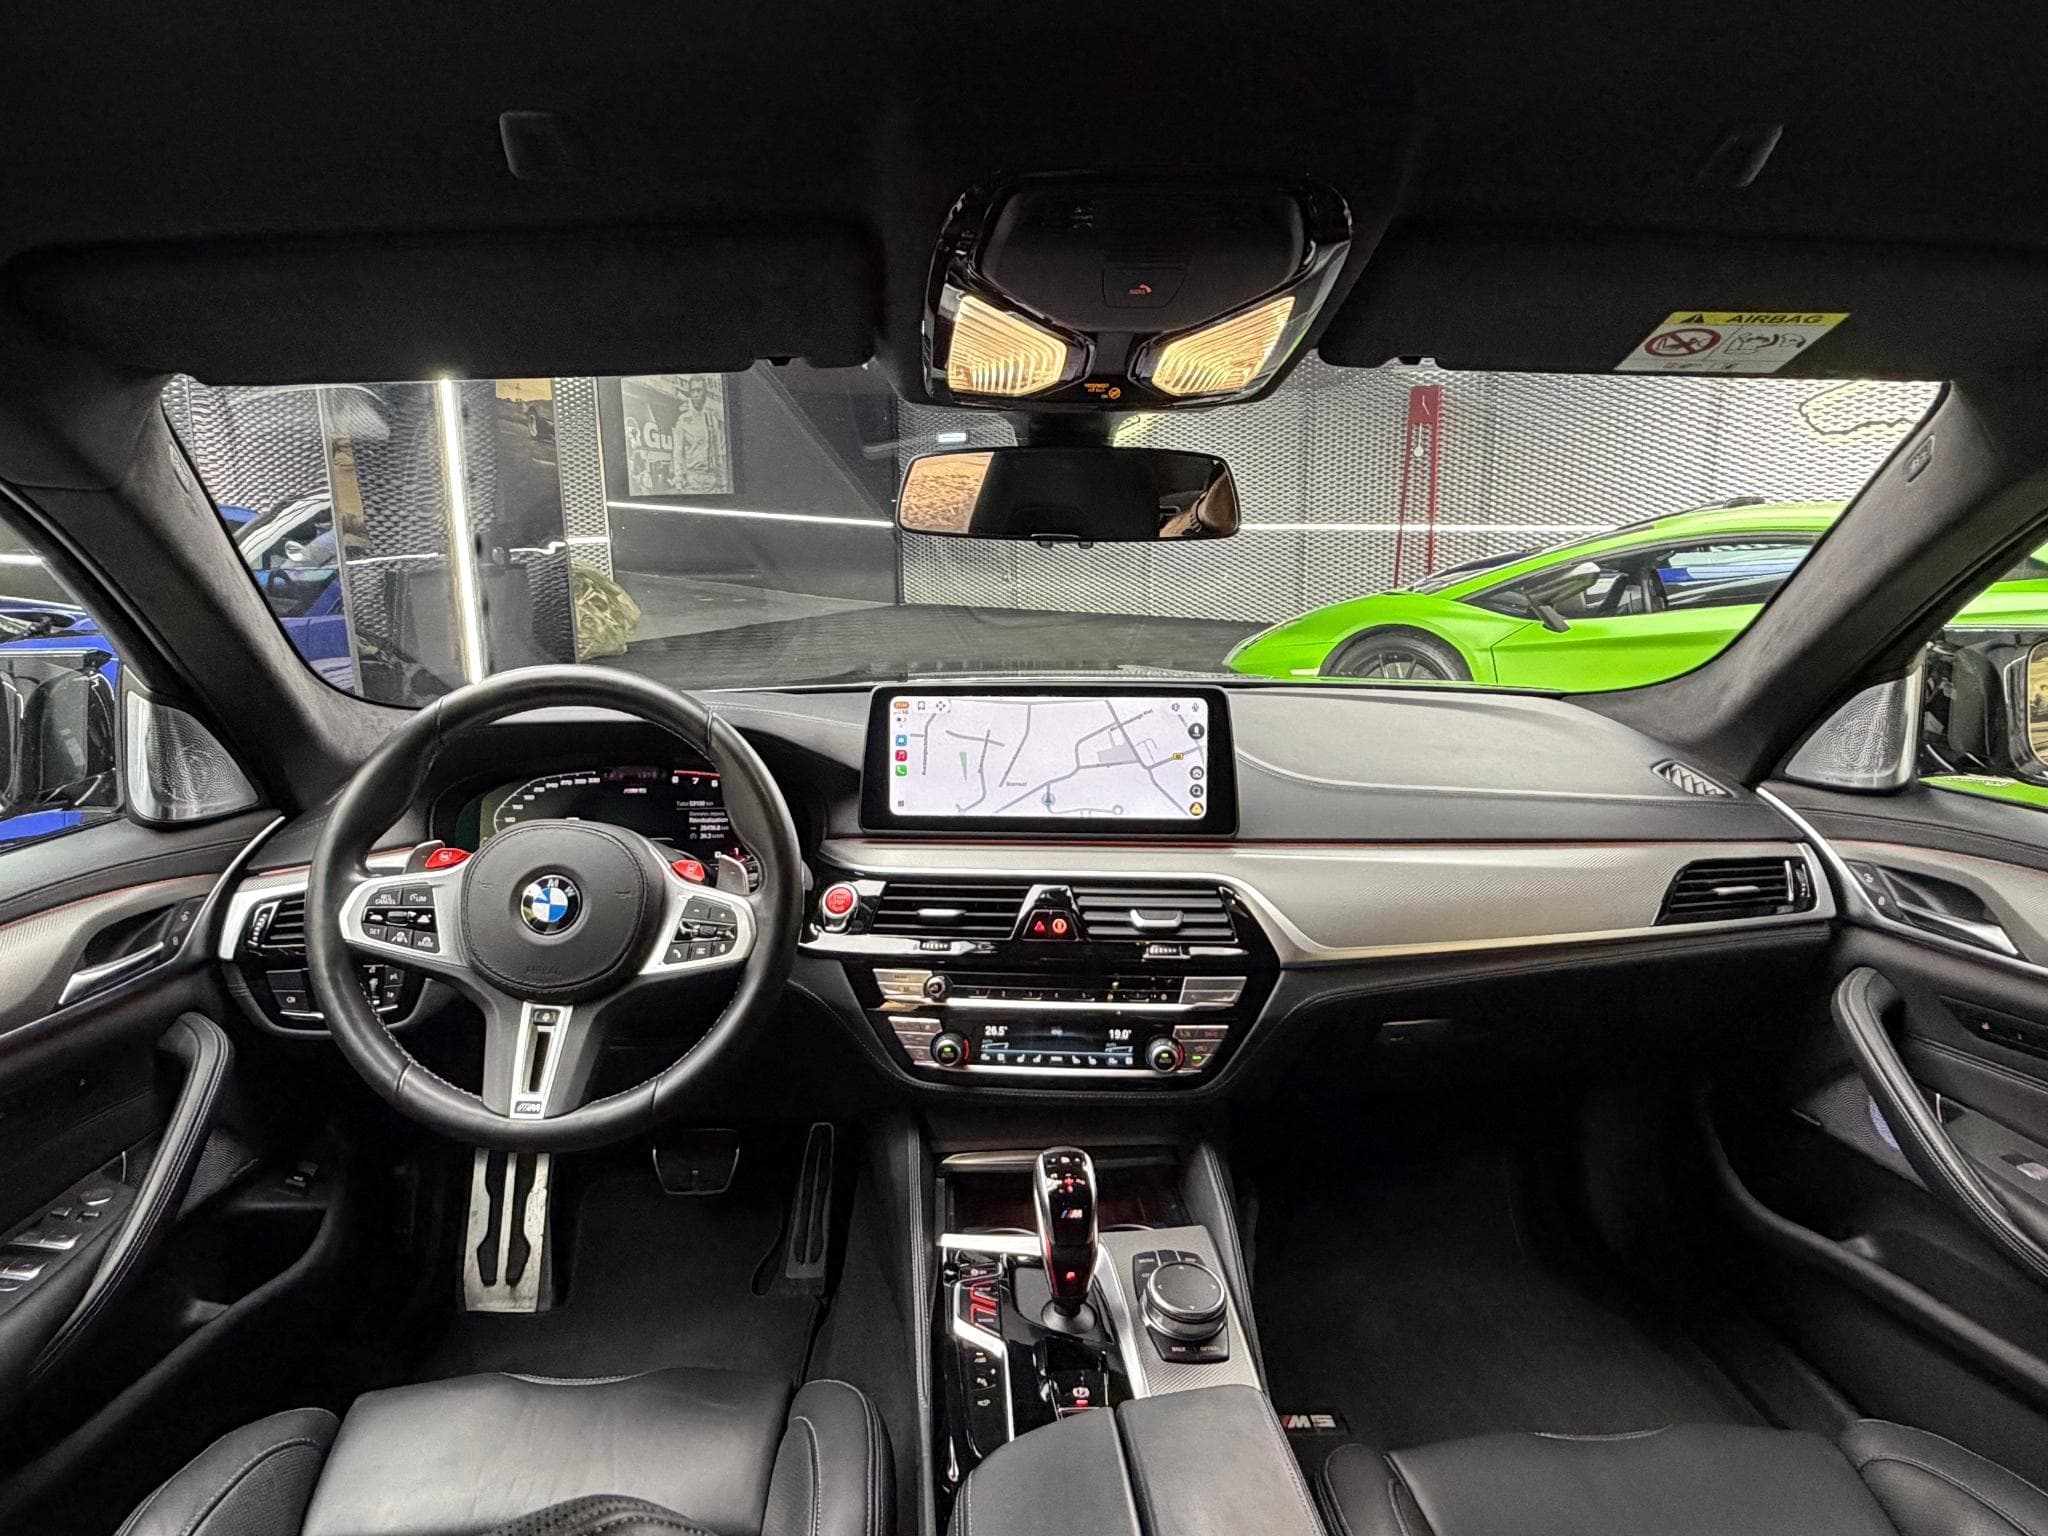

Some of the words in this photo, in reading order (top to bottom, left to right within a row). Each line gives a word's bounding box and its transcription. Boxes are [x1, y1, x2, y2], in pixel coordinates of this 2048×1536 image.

[1728, 314, 1824, 324] AIRBAG
[369, 927, 381, 935] SET
[1285, 1414, 1337, 1429] M5
